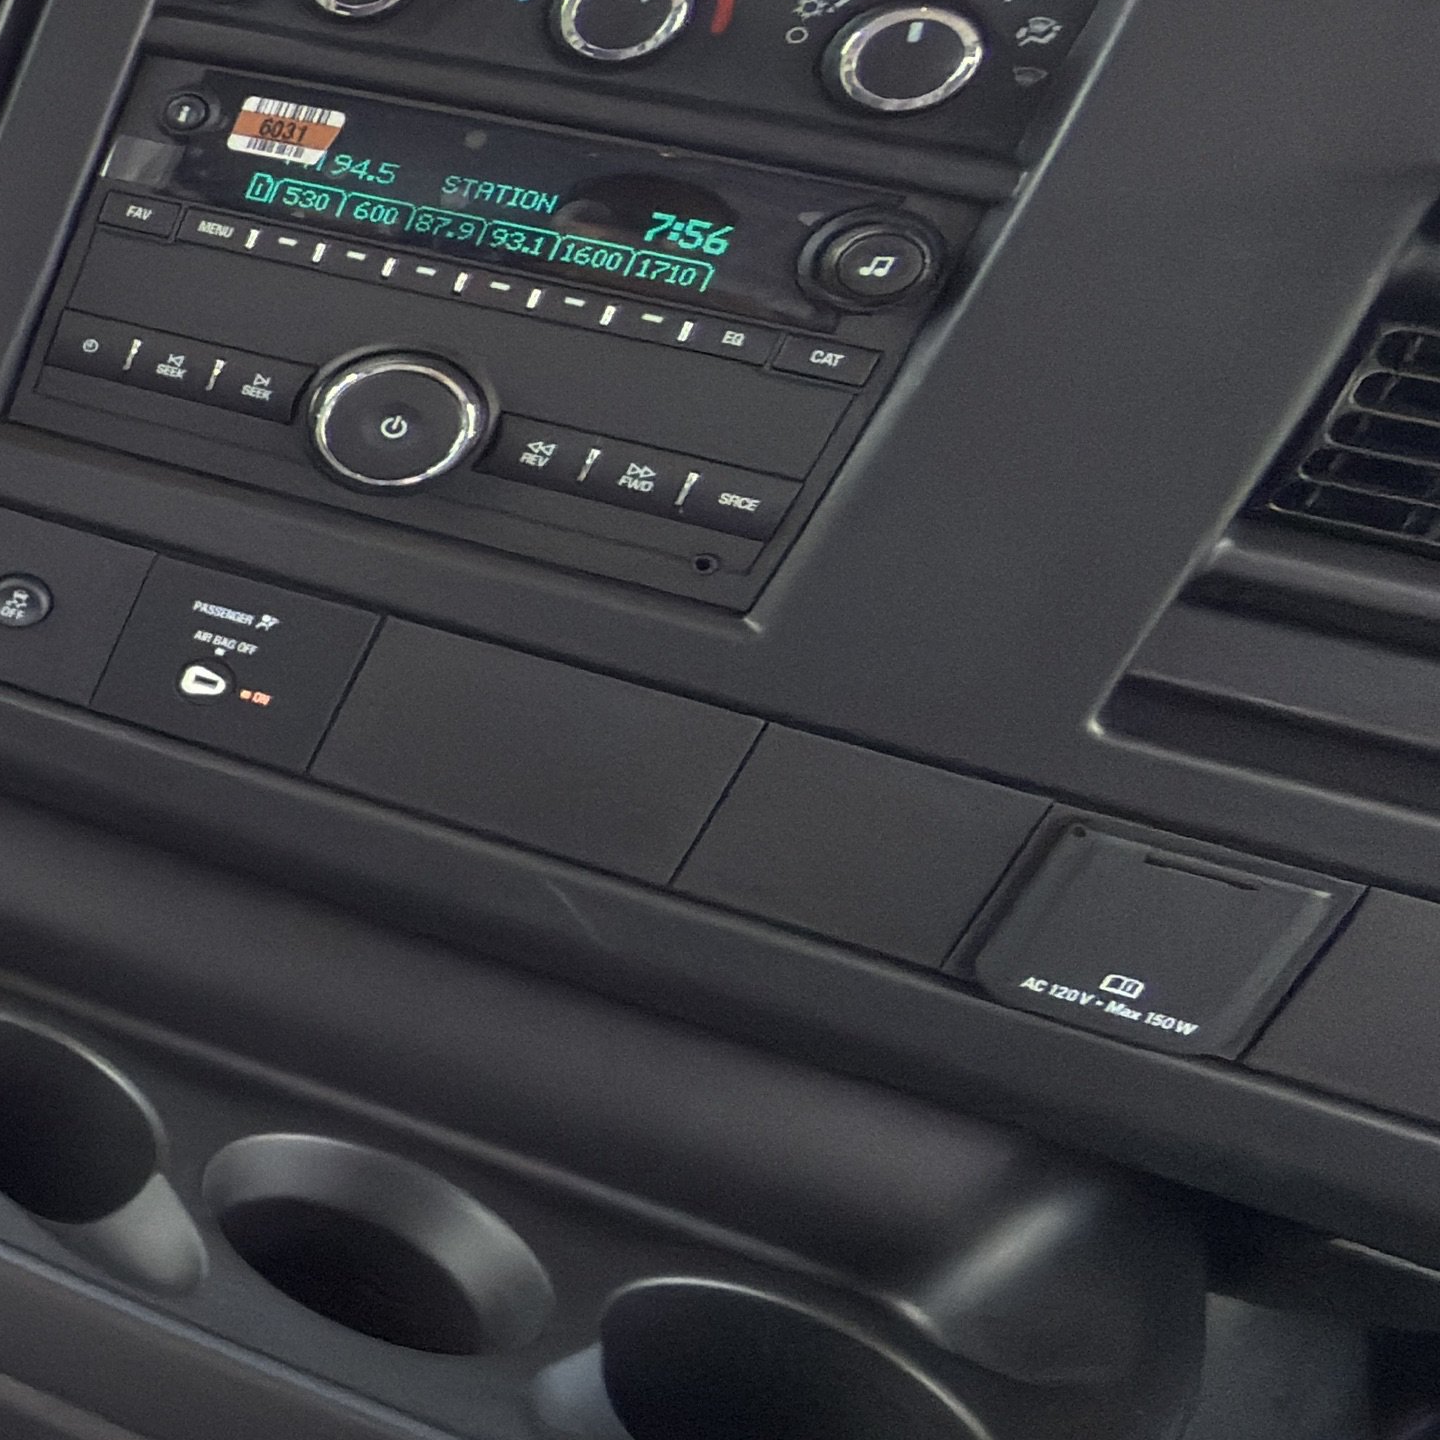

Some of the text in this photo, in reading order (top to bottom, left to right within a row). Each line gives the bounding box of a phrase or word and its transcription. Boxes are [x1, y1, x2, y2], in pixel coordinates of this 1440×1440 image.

[259, 118, 309, 143] 6031
[333, 154, 400, 185] 94.5
[441, 175, 558, 214] STATION
[125, 205, 152, 222] FAV
[197, 220, 235, 239] MENU
[283, 185, 698, 287] 530 600 87.9 93.1 1600 1710
[643, 212, 735, 255] 7:56
[721, 330, 746, 347] EQ
[809, 350, 846, 368] CAT
[155, 363, 188, 380] SEEK
[241, 384, 273, 401] SEEK
[519, 452, 550, 468] REV
[617, 476, 655, 492] FWD
[717, 492, 761, 511] SRCE
[0, 605, 25, 620] OFF
[193, 600, 255, 627] PASSENGER
[193, 629, 258, 656] AIR BAG OFF
[251, 692, 272, 706] ON
[1020, 975, 1049, 994] AC
[1104, 998, 1144, 1024] Max
